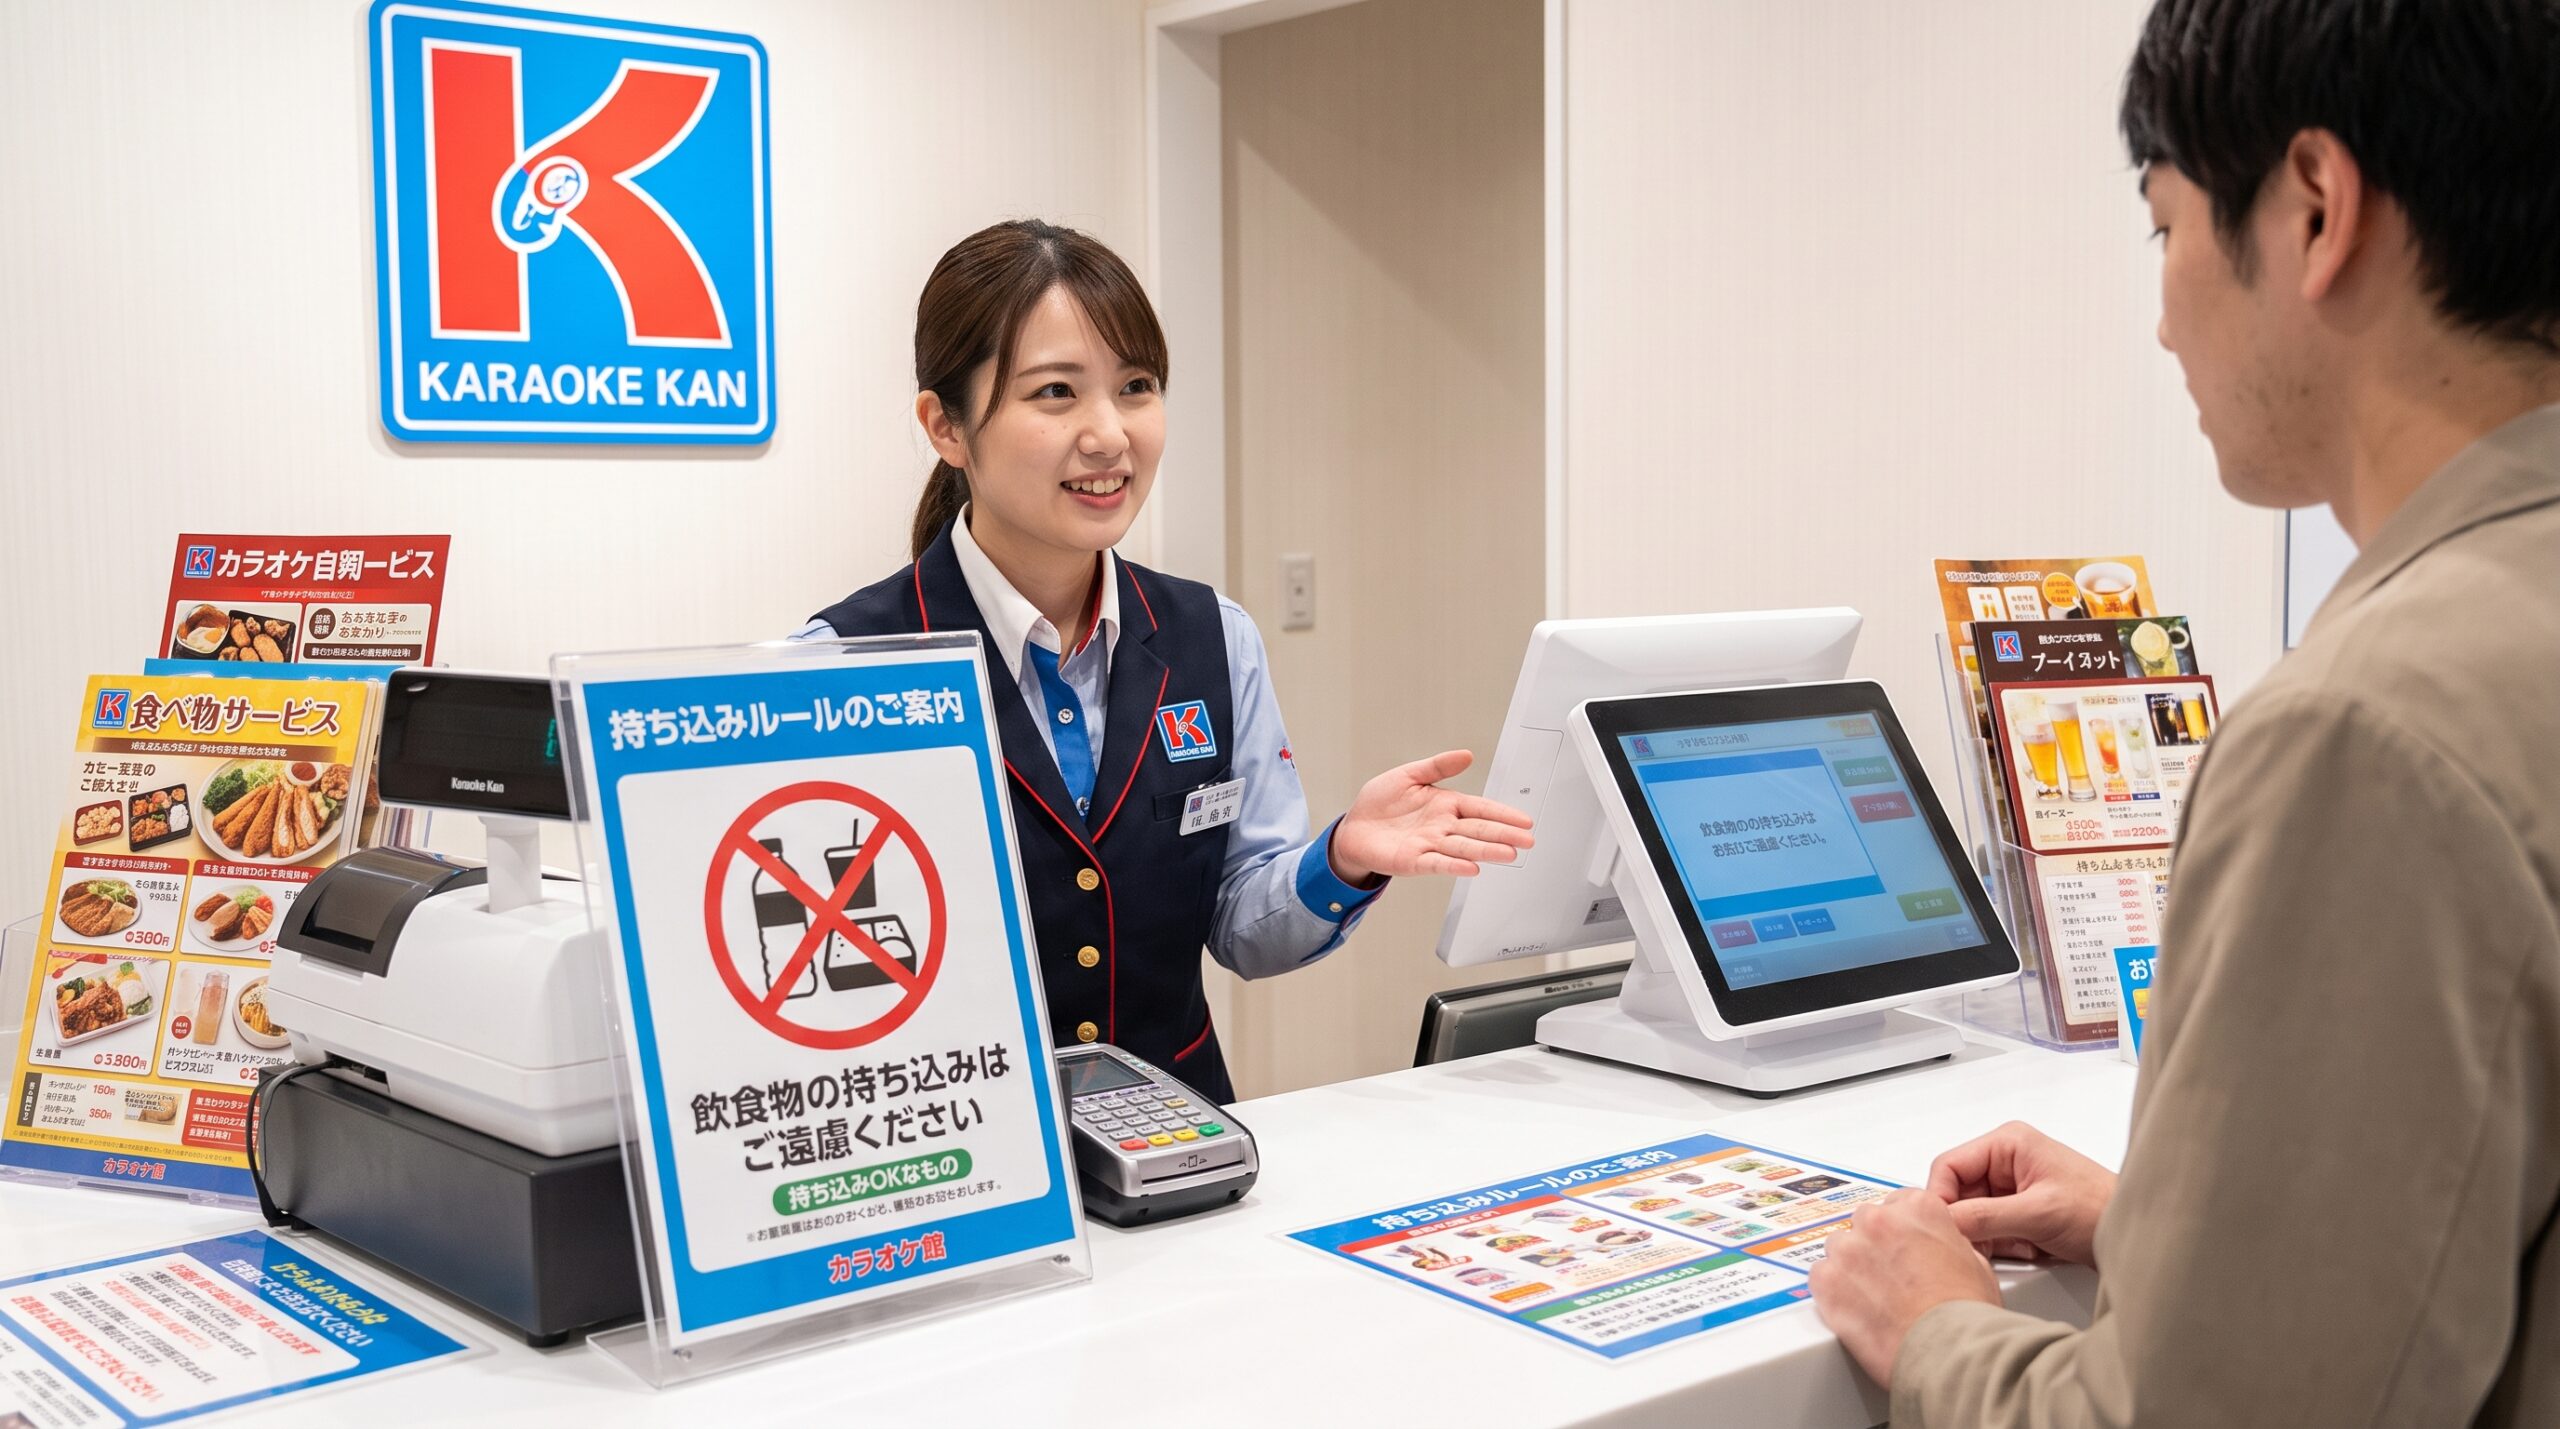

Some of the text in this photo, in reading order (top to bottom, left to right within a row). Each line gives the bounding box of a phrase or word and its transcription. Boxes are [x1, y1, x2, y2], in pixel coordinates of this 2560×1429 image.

[422, 37, 733, 350] K
[419, 361, 747, 409] KARAOKE KAN
[189, 550, 210, 570] K
[1998, 634, 2018, 656] K
[99, 693, 125, 720] K
[129, 691, 340, 734] 食べ物サービス
[608, 687, 966, 751] 持ち込みルールのご案内
[1161, 706, 1210, 749] K
[690, 1042, 1010, 1135] 飲食物の持ち込みは
[743, 1097, 983, 1173] ご遠慮ください
[788, 1155, 959, 1211] 持ち込みOKなもの
[1371, 1150, 1678, 1231] 持ち込みルールのご案内
[827, 1231, 947, 1284] カラオケ館
